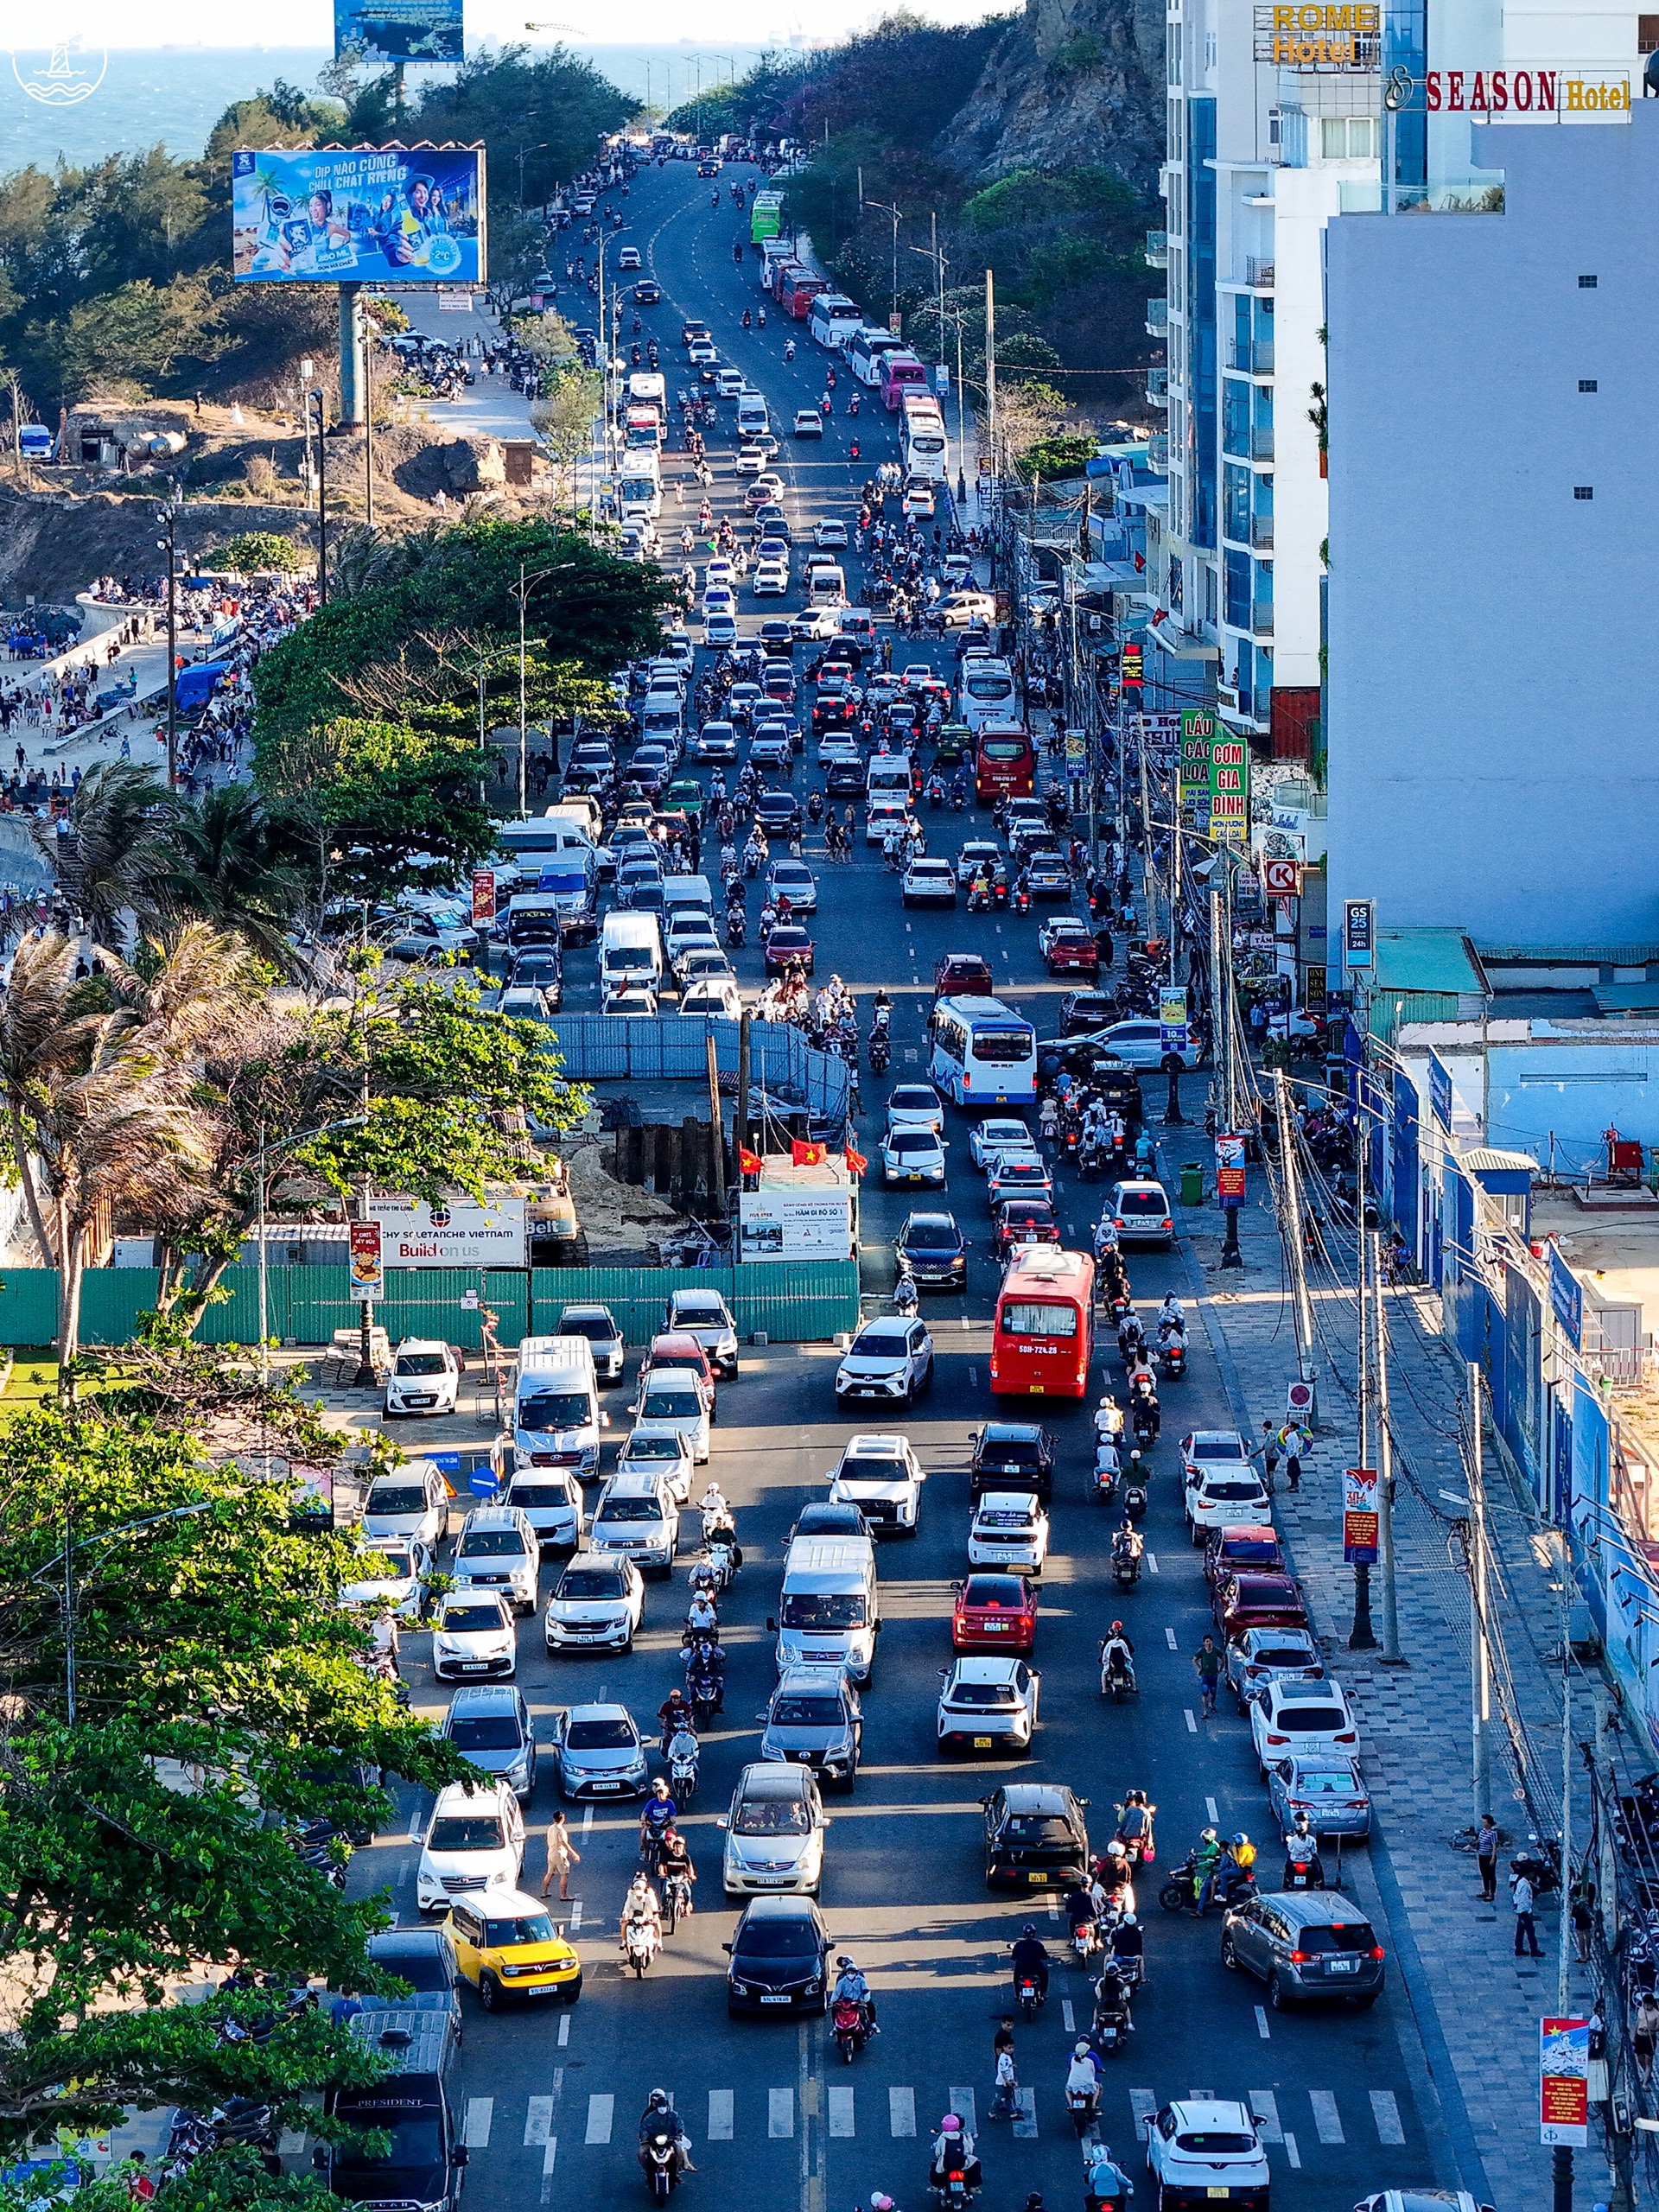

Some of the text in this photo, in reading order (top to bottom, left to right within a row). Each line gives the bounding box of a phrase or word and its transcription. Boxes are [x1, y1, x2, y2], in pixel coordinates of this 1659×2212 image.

[1273, 4, 1374, 30] ROME
[1274, 35, 1356, 62] Hotel
[1427, 71, 1630, 111] SEASON Hotel
[334, 161, 356, 175] NÀO
[359, 153, 397, 172] CŨNG
[308, 179, 333, 192] CHILL
[1185, 712, 1211, 735] LẨU
[1214, 744, 1243, 764] CƠM
[1183, 764, 1209, 784] LOẠ
[1217, 770, 1240, 789] GIA
[1213, 791, 1244, 816] ĐÌNH
[1351, 907, 1367, 917] GS
[1351, 918, 1367, 928] 25
[1309, 969, 1325, 977] ONE
[381, 1230, 400, 1239] CHY
[399, 1243, 480, 1257] Build on us
